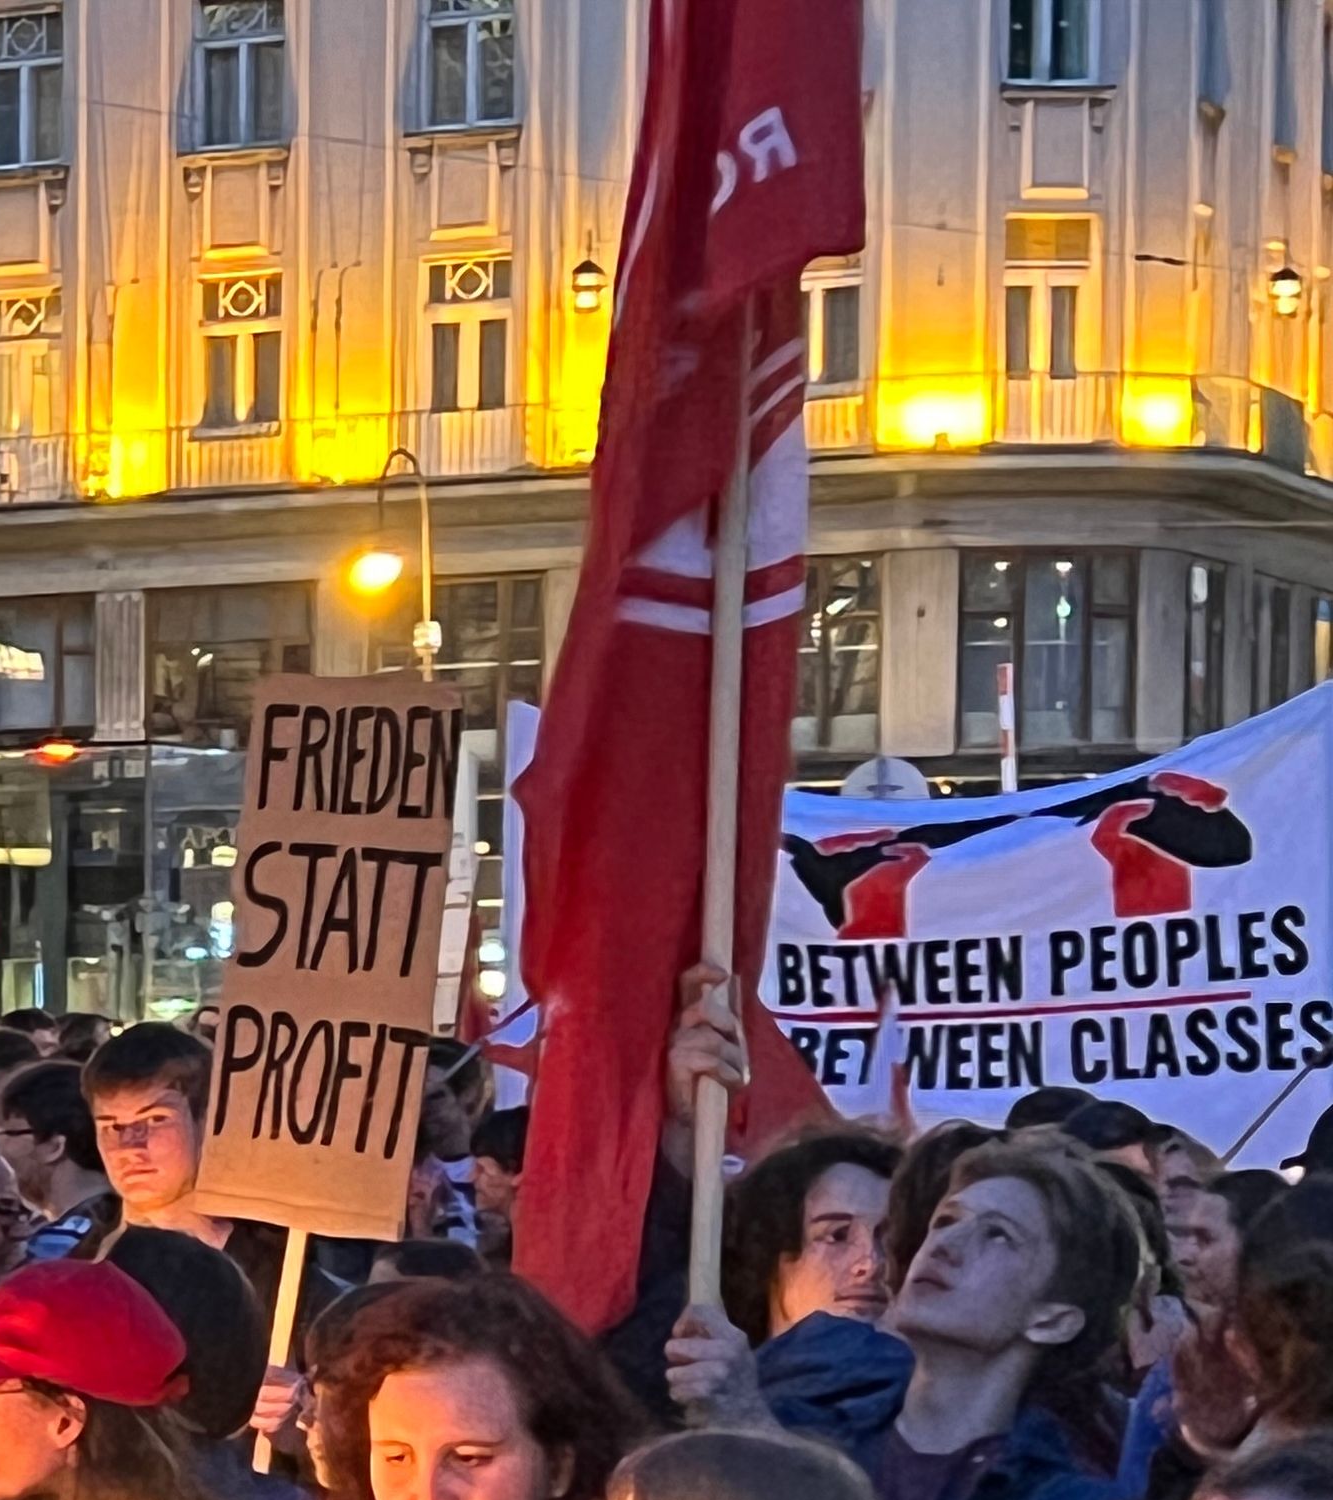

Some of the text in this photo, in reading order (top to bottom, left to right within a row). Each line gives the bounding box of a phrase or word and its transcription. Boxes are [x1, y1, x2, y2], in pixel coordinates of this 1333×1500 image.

[257, 703, 462, 820] FRIEDEN
[236, 841, 442, 978] STATT
[778, 905, 1309, 1007] BETWEEN PEOPLES
[213, 1004, 431, 1159] PROFIT
[1069, 1000, 1333, 1084] CLASSES
